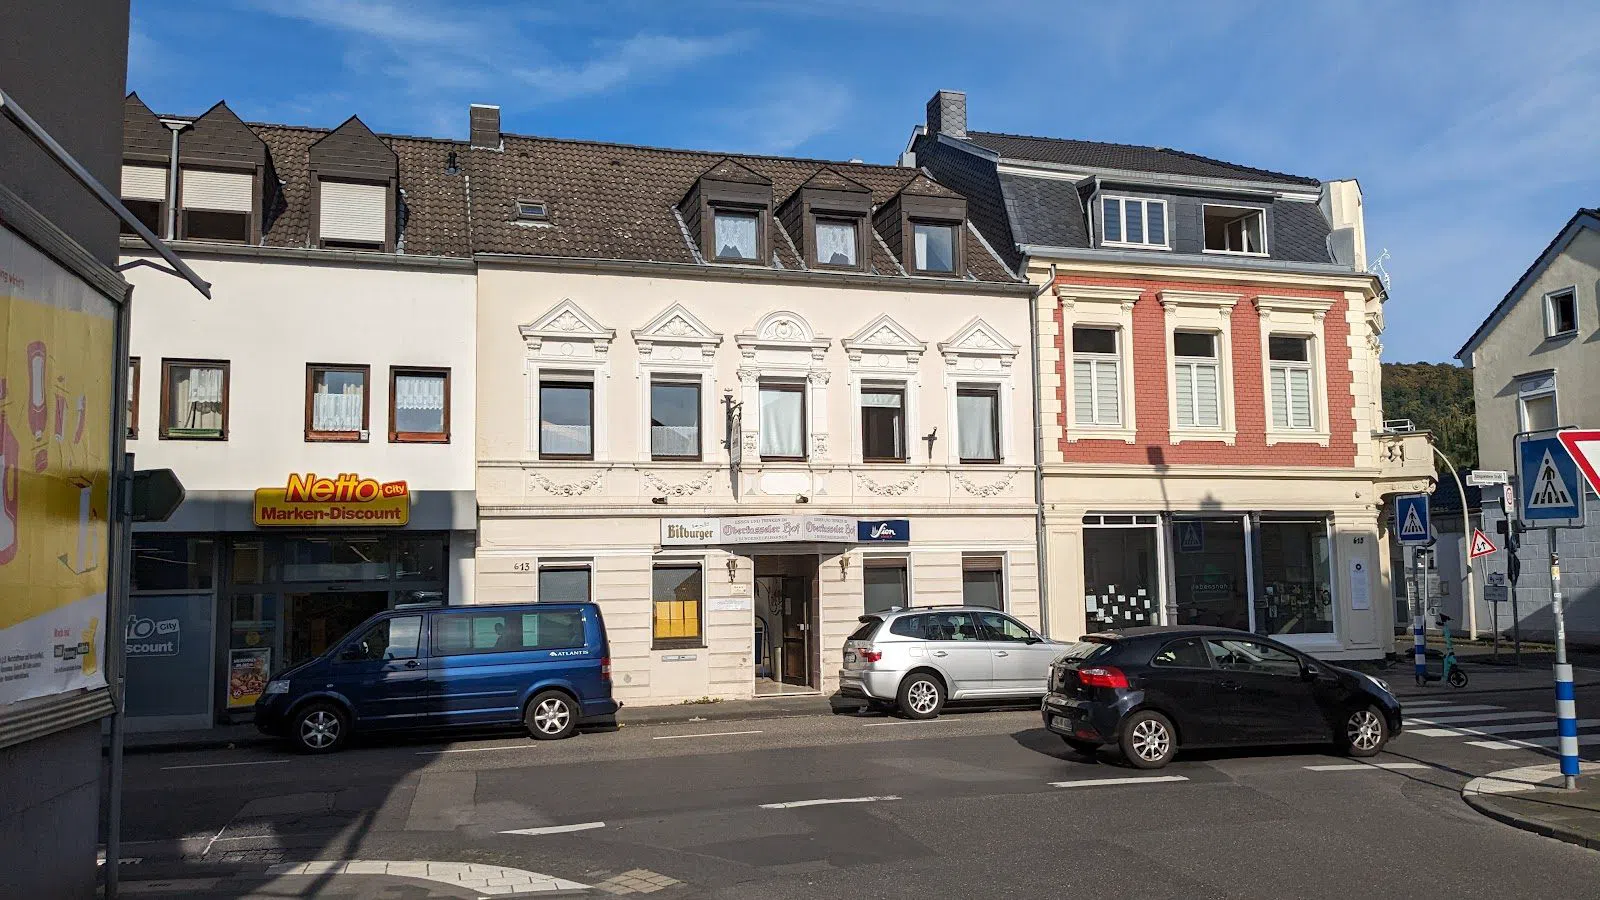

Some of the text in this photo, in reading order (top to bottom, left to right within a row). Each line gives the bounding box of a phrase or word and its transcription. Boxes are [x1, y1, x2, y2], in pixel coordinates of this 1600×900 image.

[286, 473, 405, 502] Netto City
[261, 507, 402, 520] Marken-Discount
[667, 524, 714, 540] Bitburger
[514, 562, 530, 571] 613
[160, 622, 177, 631] City
